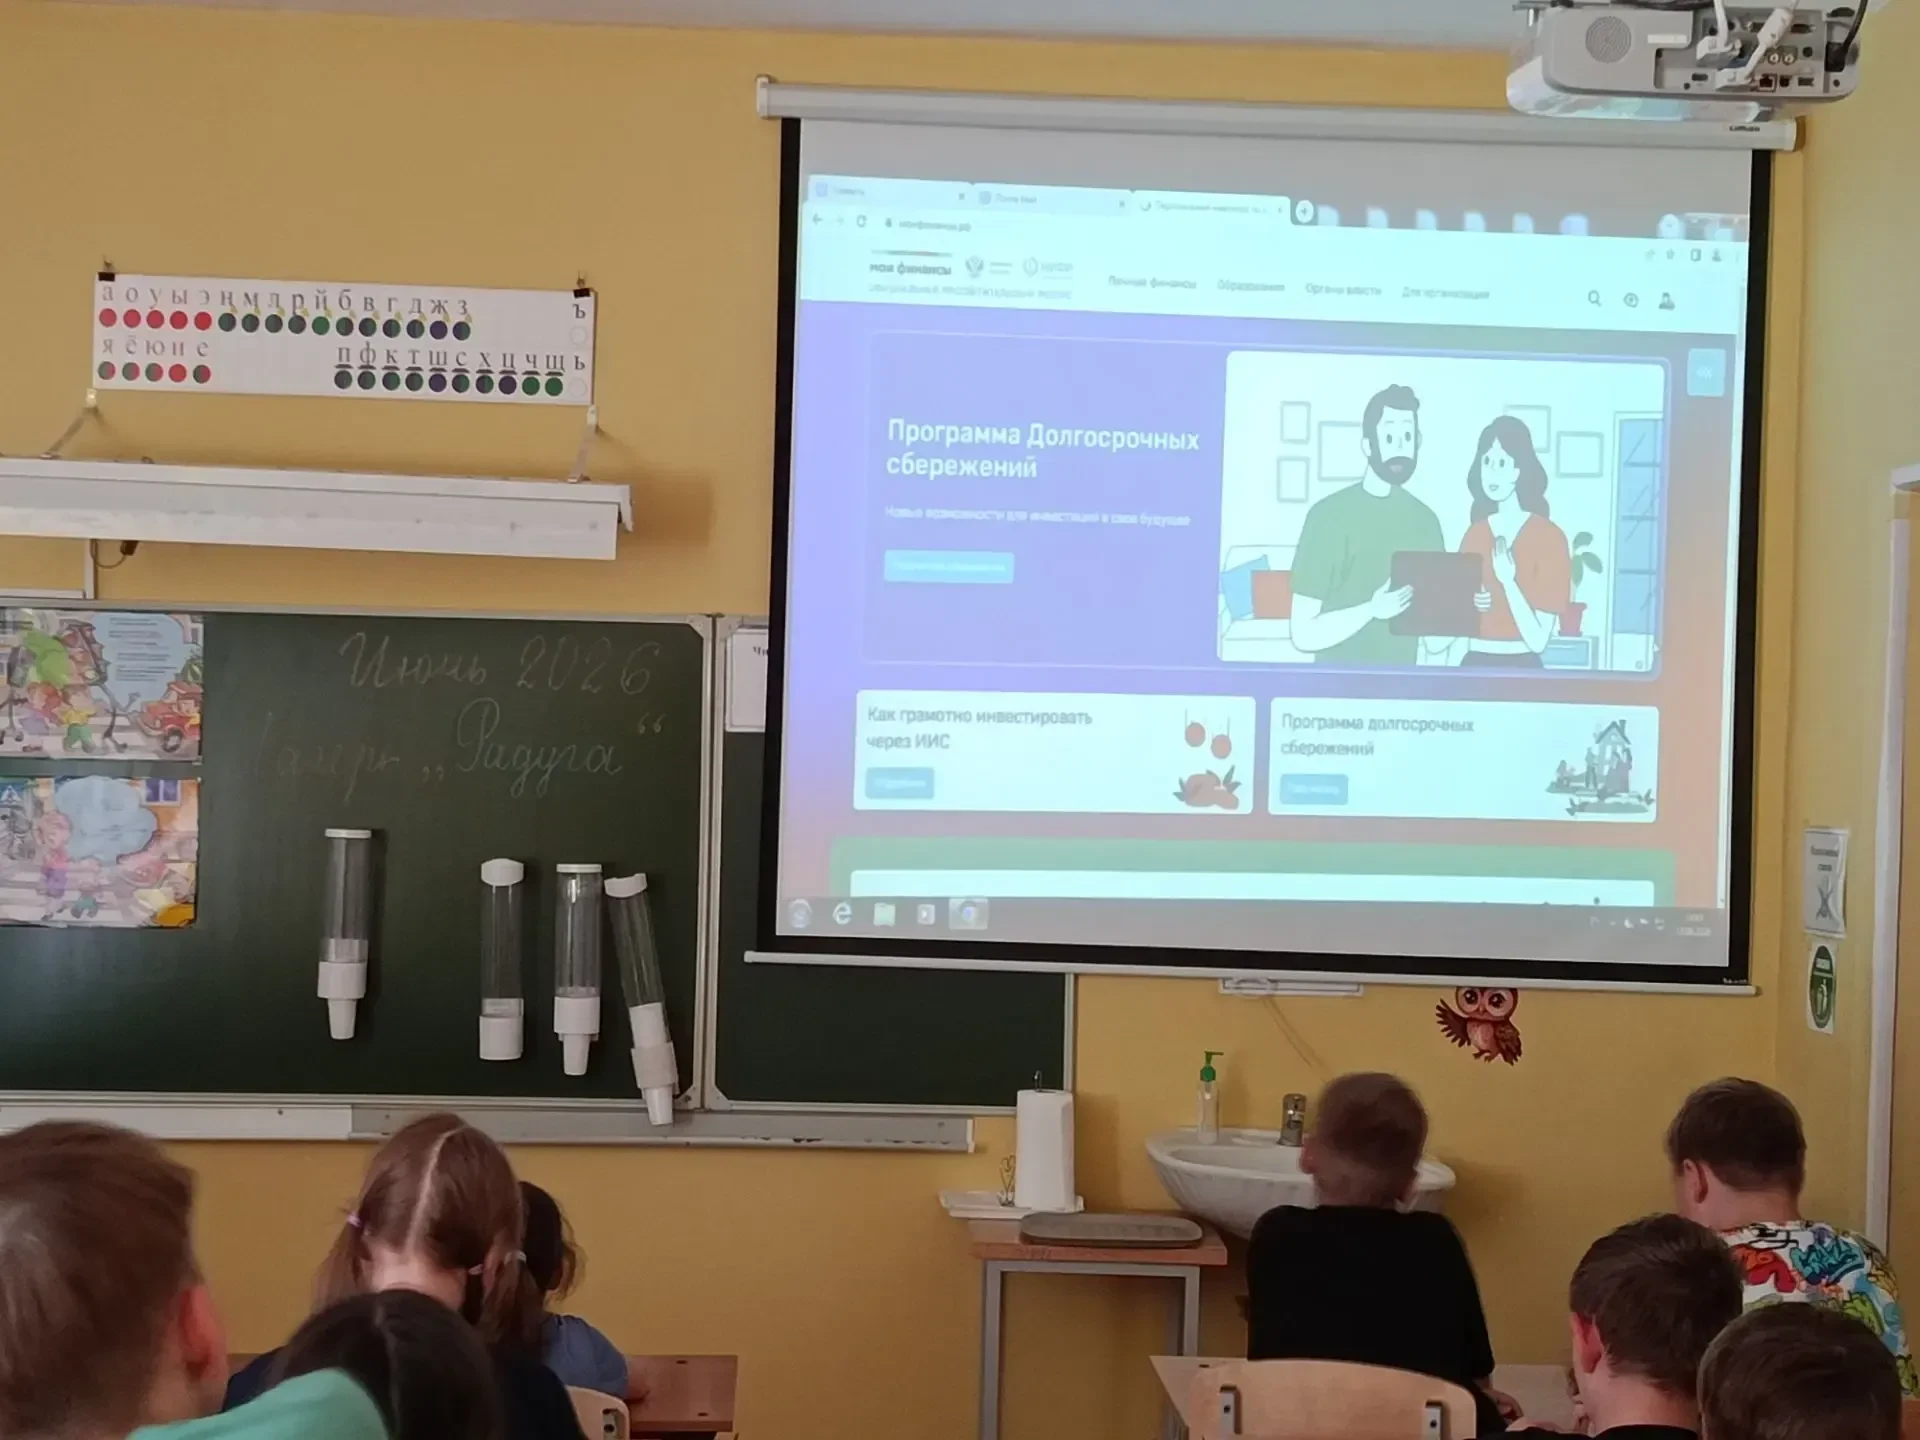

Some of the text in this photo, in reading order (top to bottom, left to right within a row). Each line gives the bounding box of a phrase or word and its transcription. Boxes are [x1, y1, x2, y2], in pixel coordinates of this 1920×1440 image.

[888, 417, 1200, 453] Программа Долгосрочных
[886, 452, 1038, 481] сбережений
[516, 635, 662, 694] 2026
[867, 706, 1093, 727] Как грамотно инвестировать
[1281, 713, 1475, 734] Программа долгосрочных
[866, 734, 950, 751] через ИИС
[1280, 740, 1375, 758] сбережений
